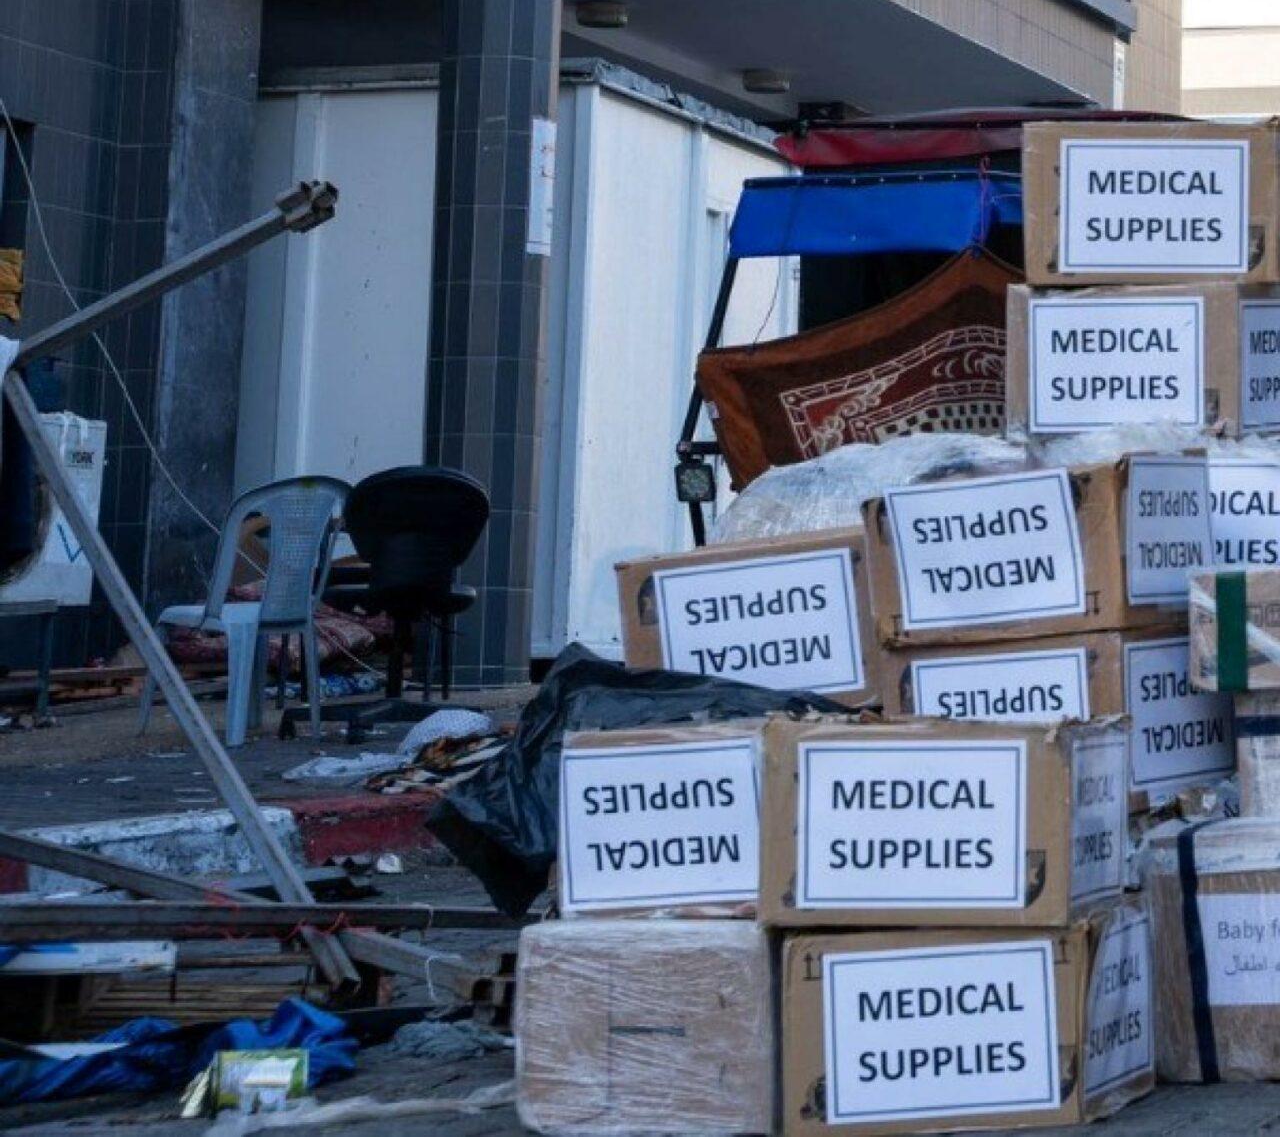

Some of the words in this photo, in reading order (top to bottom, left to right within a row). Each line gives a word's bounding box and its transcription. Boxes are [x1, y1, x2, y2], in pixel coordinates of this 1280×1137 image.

[1088, 170, 1223, 195] MEDICAL
[1086, 217, 1223, 243] SUPPLIES
[1051, 327, 1179, 354] MEDICAL
[1050, 375, 1180, 402] SUPPLIES
[1139, 489, 1200, 518] SUPPLIES
[912, 504, 1049, 544] SUPPLIES
[1139, 541, 1203, 569] MEDICAL
[921, 555, 1056, 594] MEDICAL
[684, 584, 827, 626] SUPPLIES
[688, 634, 832, 675] MEDICAL
[938, 684, 1063, 720] SUPPLIES
[1142, 718, 1224, 755] MEDICAL
[582, 777, 735, 816] SUPPLIES
[832, 779, 995, 810] MEDICAL
[586, 833, 741, 872] MEDICAL
[829, 837, 994, 870] SUPPLIES
[1217, 920, 1265, 943] Baby
[858, 981, 1024, 1023] MEDICAL
[1088, 1009, 1142, 1059] SUPPLIES
[858, 1040, 1027, 1083] SUPPLIES
